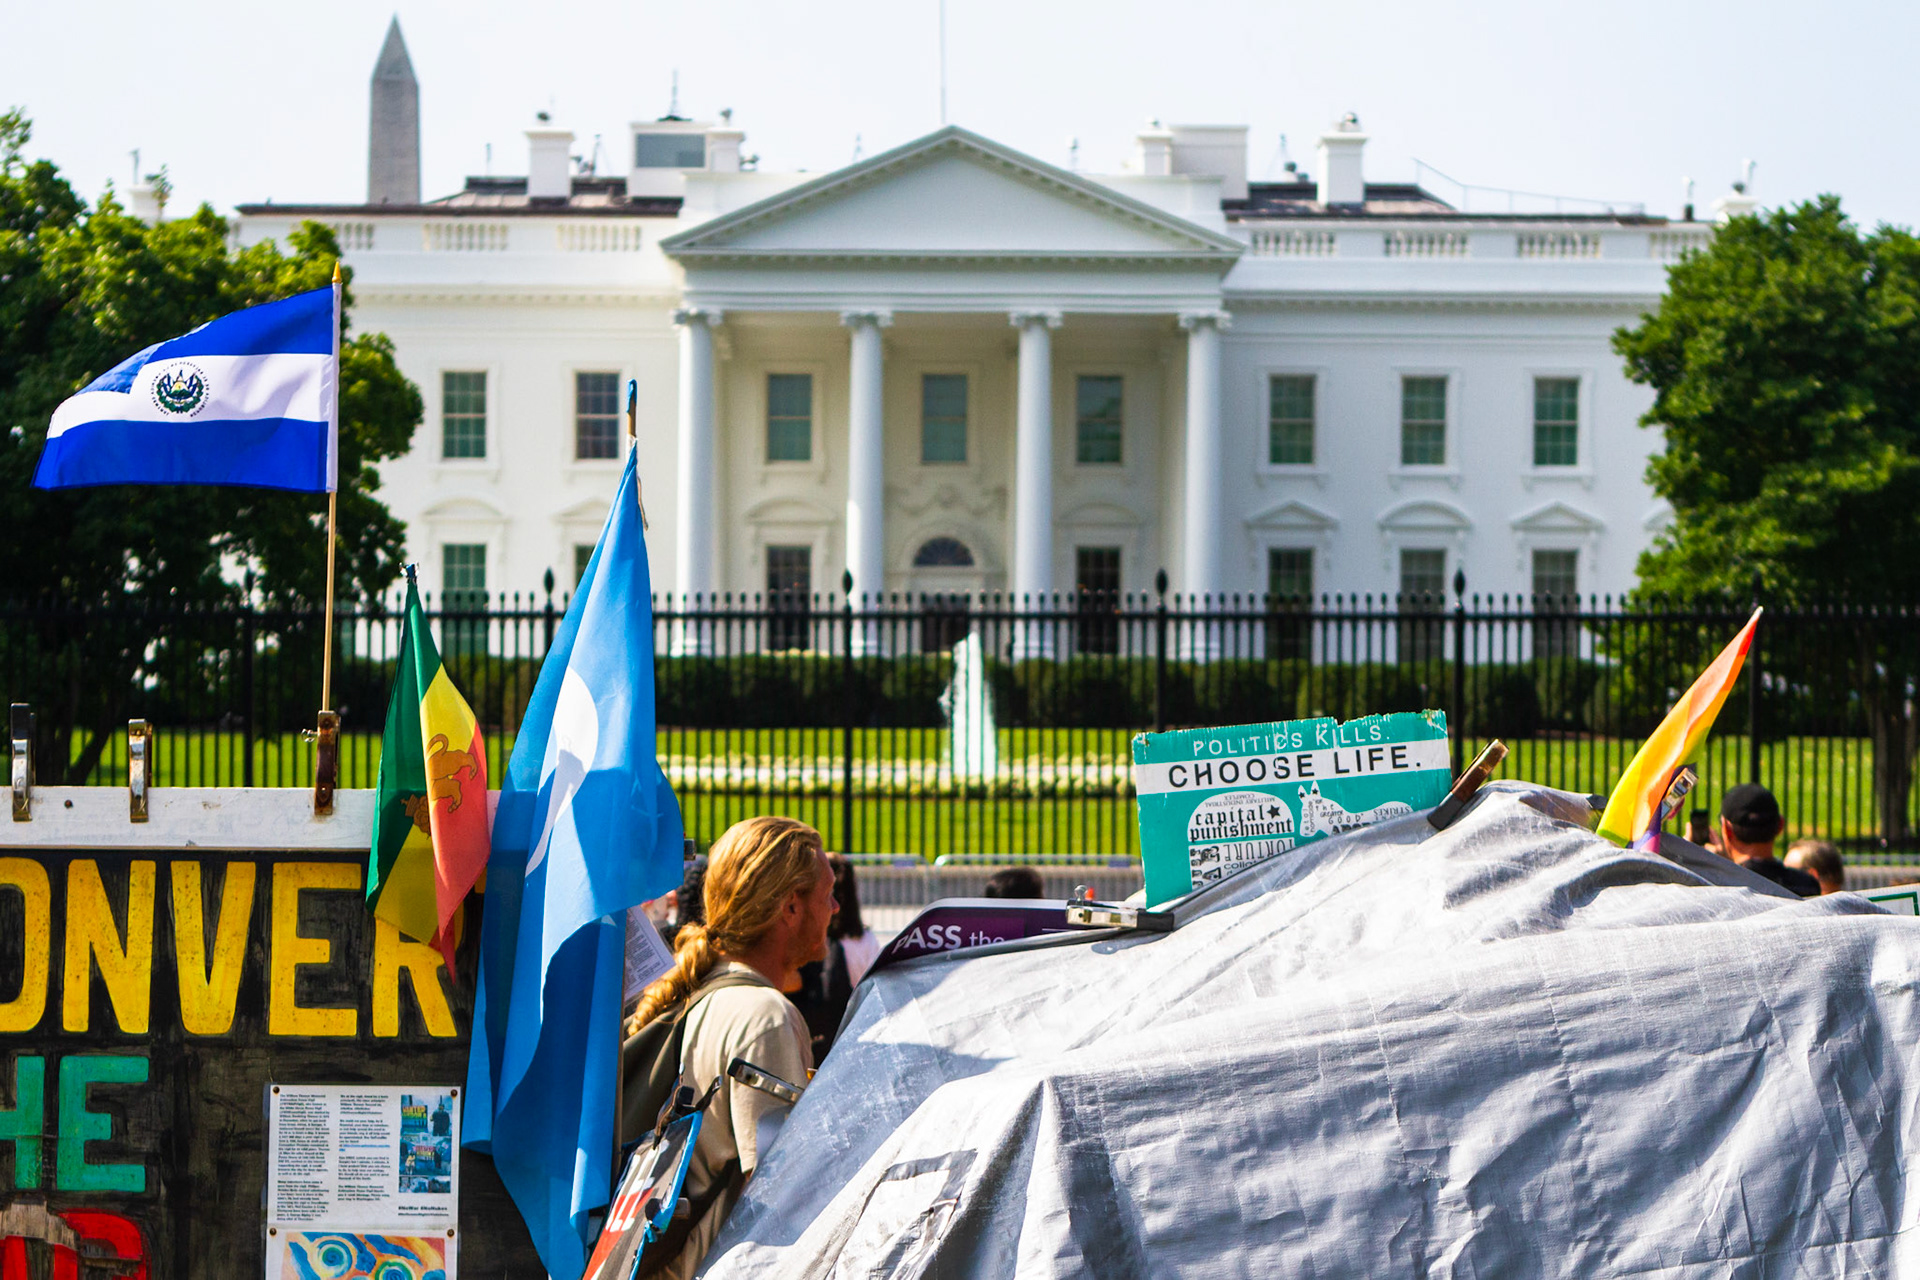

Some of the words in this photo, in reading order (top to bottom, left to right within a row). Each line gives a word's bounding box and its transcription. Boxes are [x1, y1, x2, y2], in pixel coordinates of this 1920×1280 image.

[1193, 731, 1303, 757] POLITICS
[1315, 723, 1391, 746] KILLS.
[1168, 753, 1315, 788] CHOOSE
[1334, 745, 1422, 775] LIFE.
[1195, 805, 1265, 826] capital
[1373, 806, 1411, 817] STRIKES
[1190, 818, 1292, 843] punishment
[0, 857, 485, 1038] ONVER
[890, 924, 962, 955] PASS
